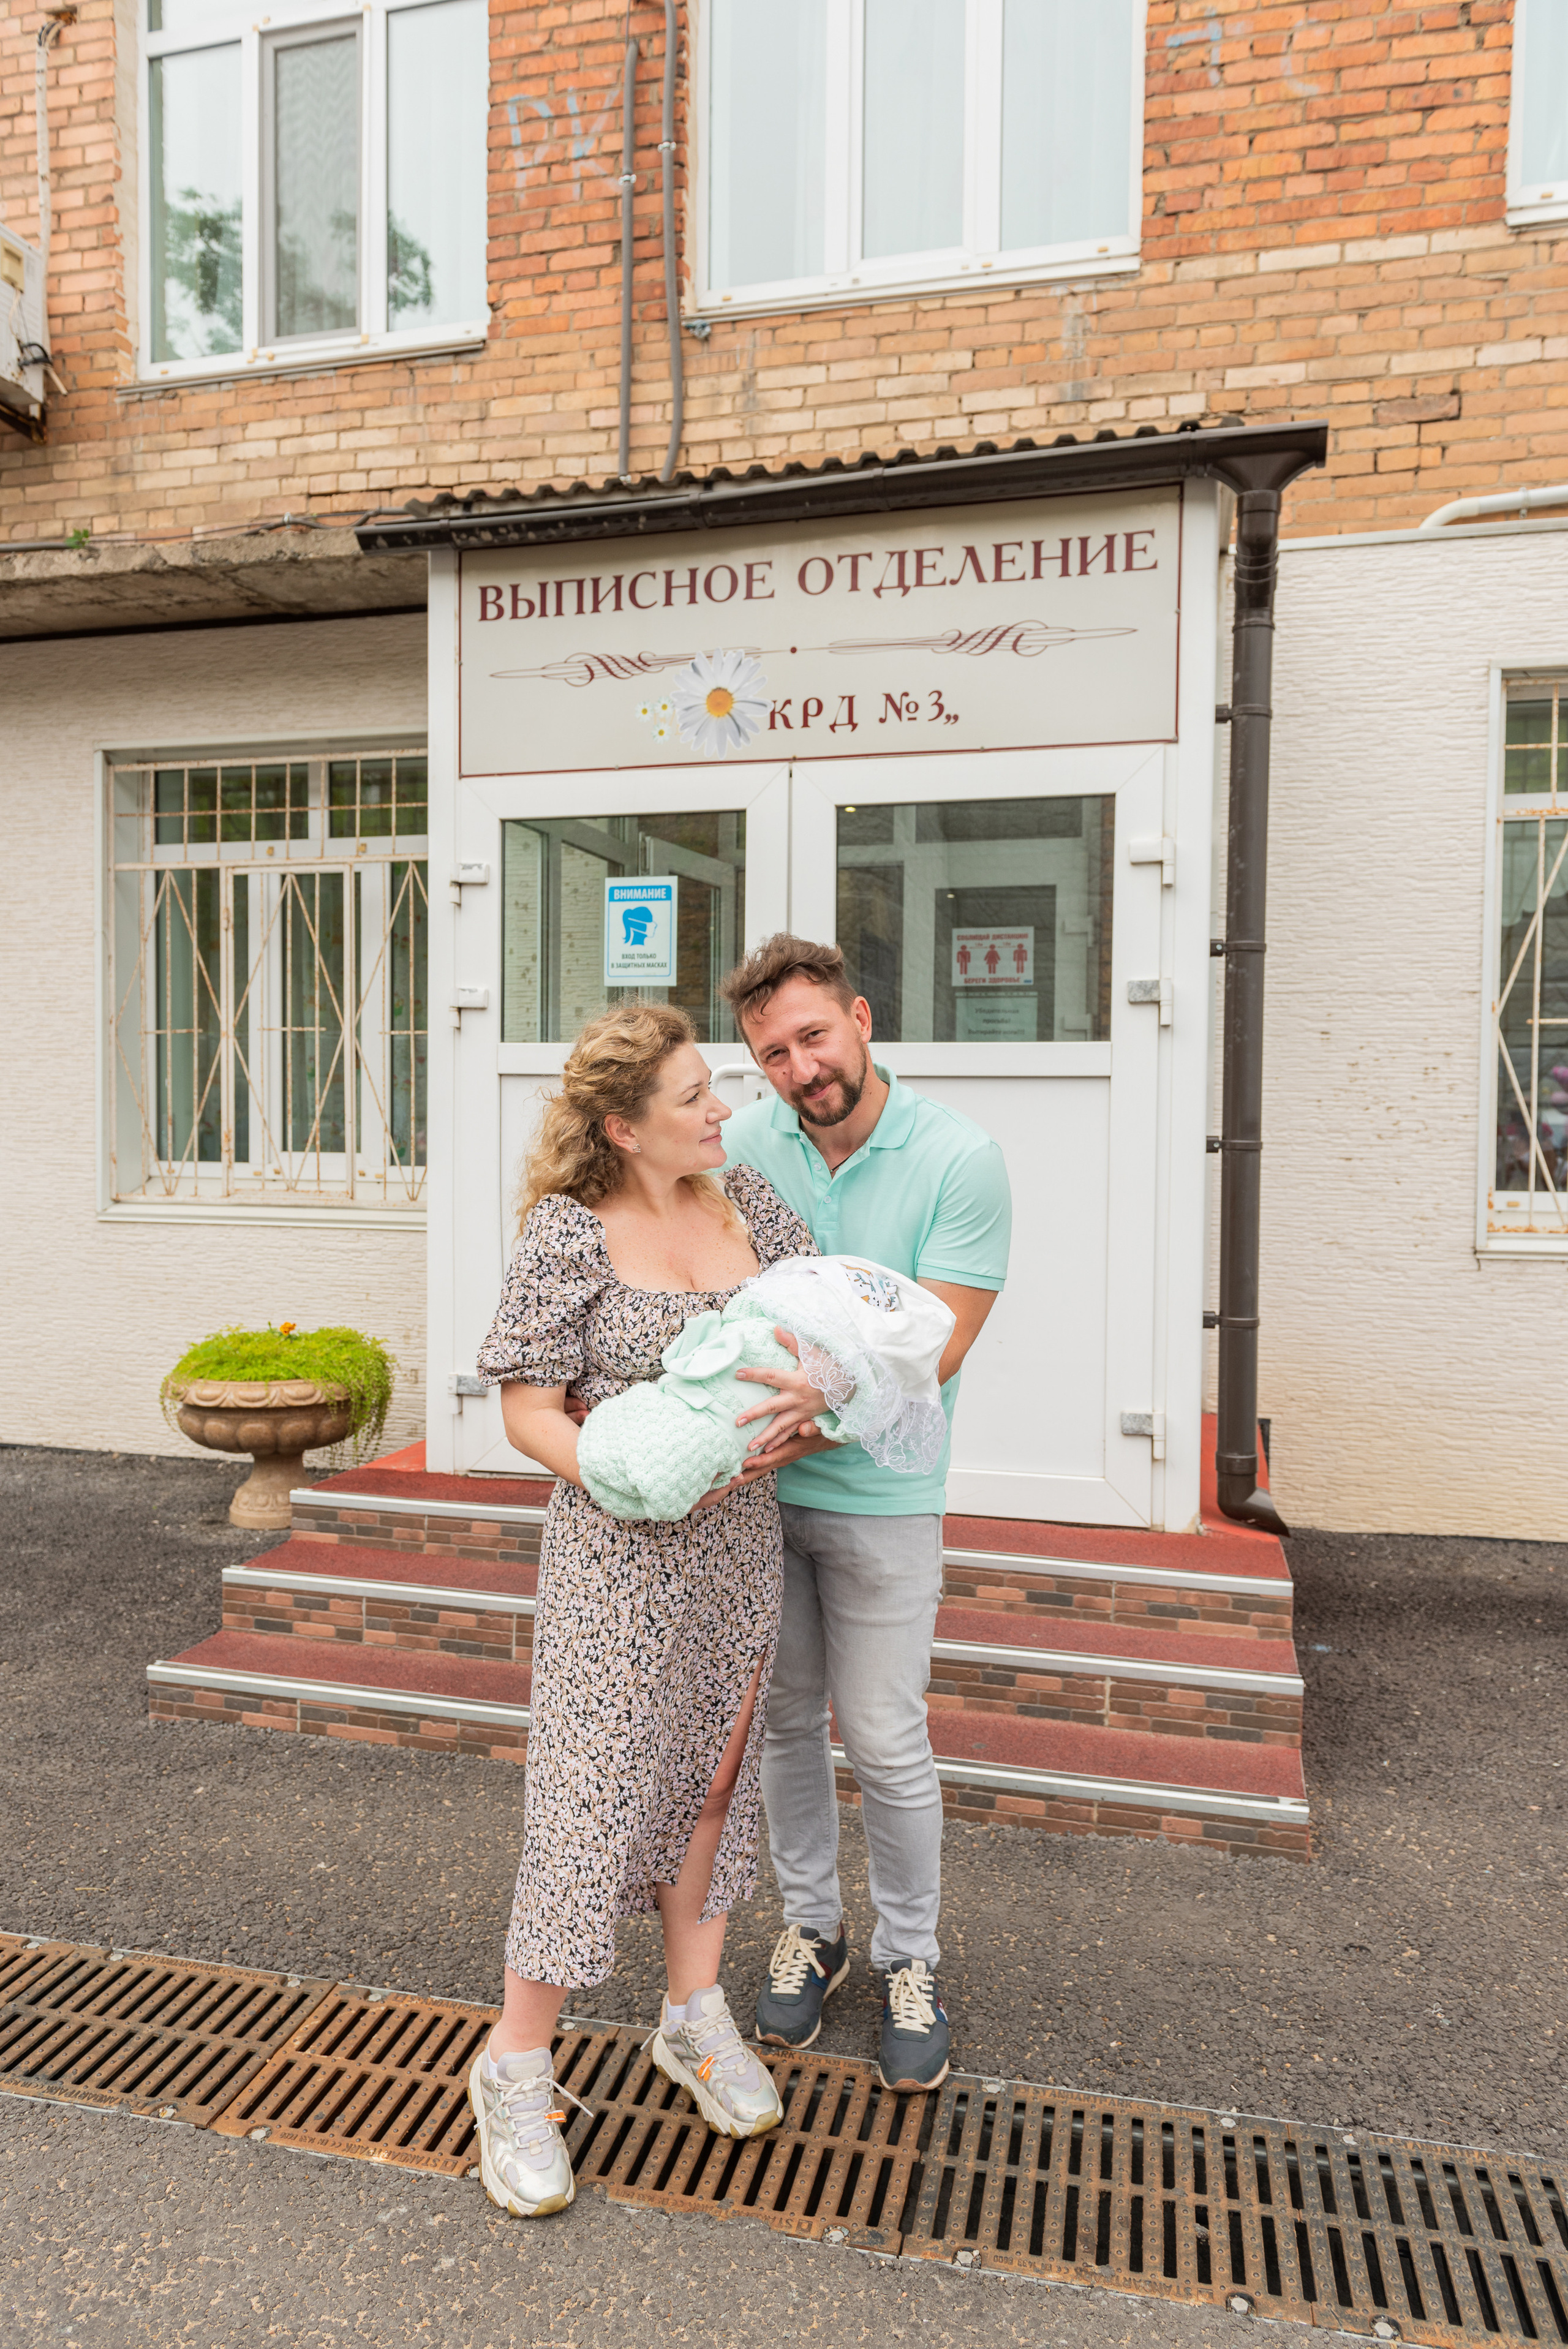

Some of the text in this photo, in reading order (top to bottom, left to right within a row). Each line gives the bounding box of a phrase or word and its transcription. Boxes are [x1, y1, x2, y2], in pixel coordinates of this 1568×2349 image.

[478, 529, 1158, 622] ВЫПИСНОЕ ОТДЕЛЕНИЕ
[767, 695, 859, 733] КРД
[614, 888, 666, 900] ВНИМАНИЕ
[1031, 2087, 1133, 2109] STANDARTPARK
[342, 2143, 440, 2168] STANDARTPARK
